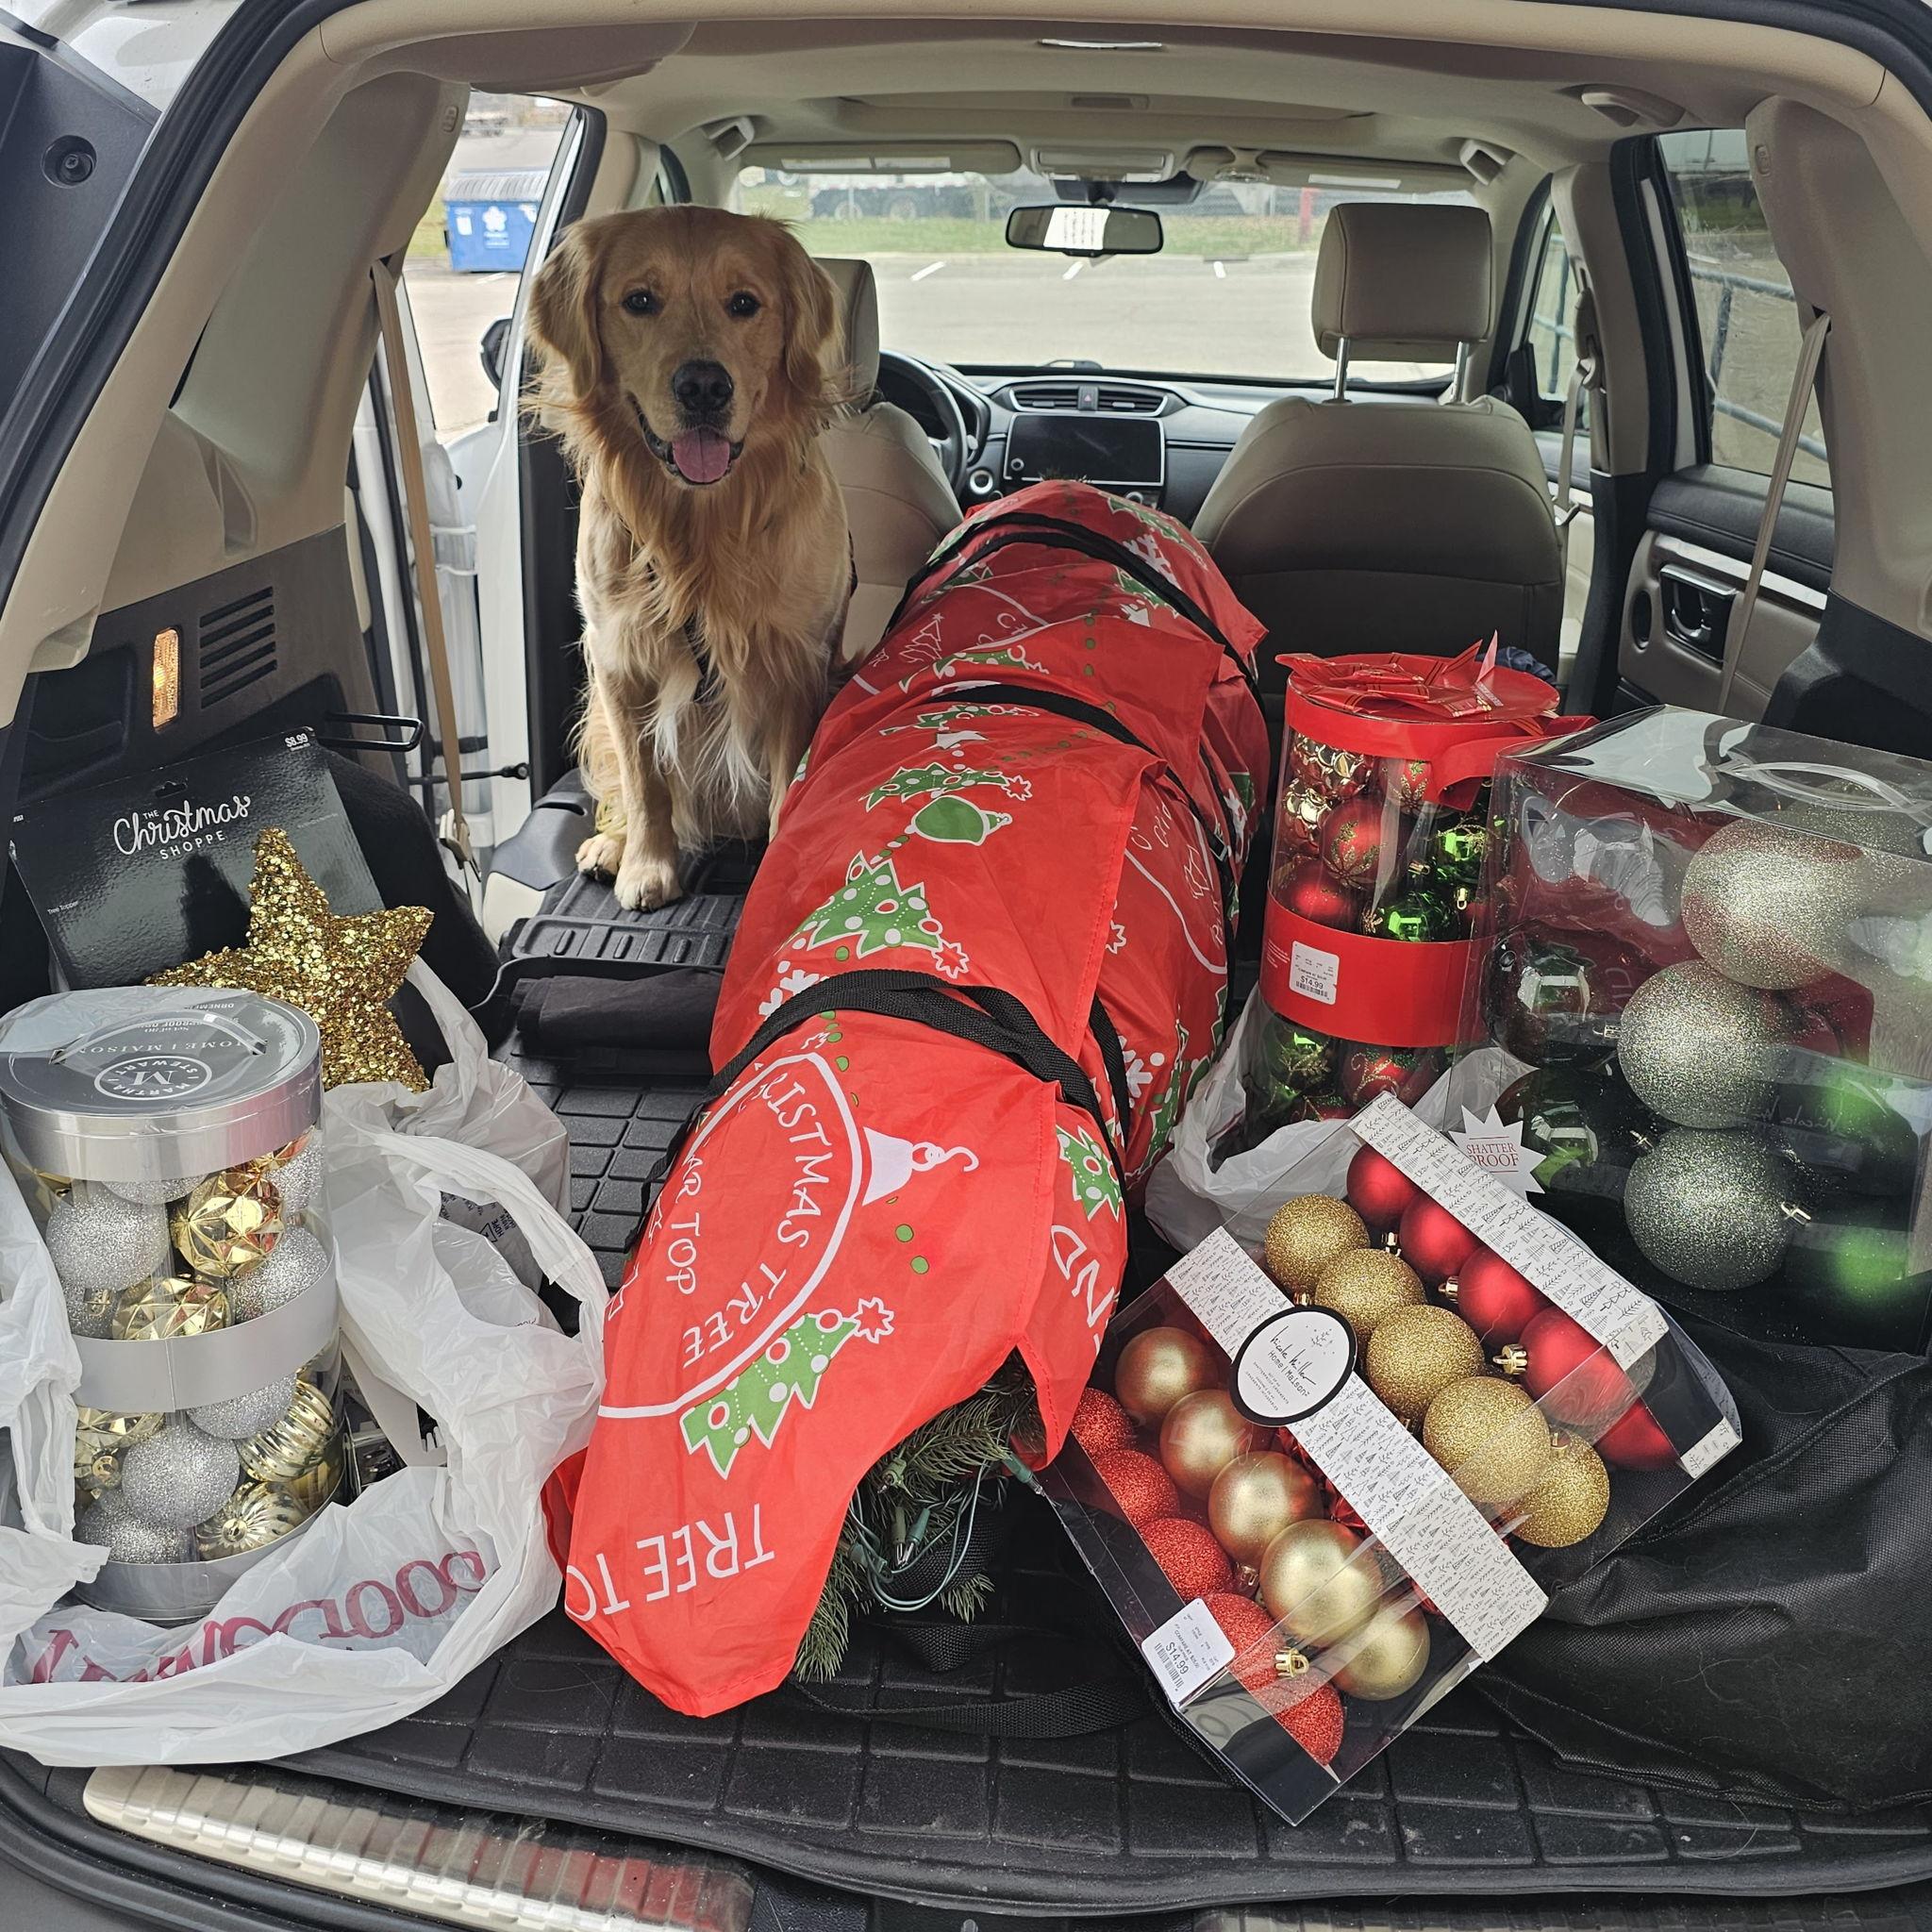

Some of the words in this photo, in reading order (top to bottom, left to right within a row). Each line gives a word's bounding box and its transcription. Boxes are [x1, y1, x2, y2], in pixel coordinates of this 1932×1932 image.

[284, 732, 308, 747] $8.99
[142, 809, 159, 820] THE
[113, 795, 251, 856] Christmas
[159, 830, 225, 859] SHOPPE
[1300, 974, 1324, 990] $14.99
[115, 1059, 199, 1075] STEWART
[112, 1082, 192, 1096] MARTHA
[1466, 1141, 1517, 1155] SHATTER
[491, 1219, 505, 1238] HDPE
[666, 1213, 701, 1295] TOP
[681, 1259, 787, 1369] TREE
[635, 1503, 775, 1603] TREE
[1165, 1641, 1190, 1674] $14.99
